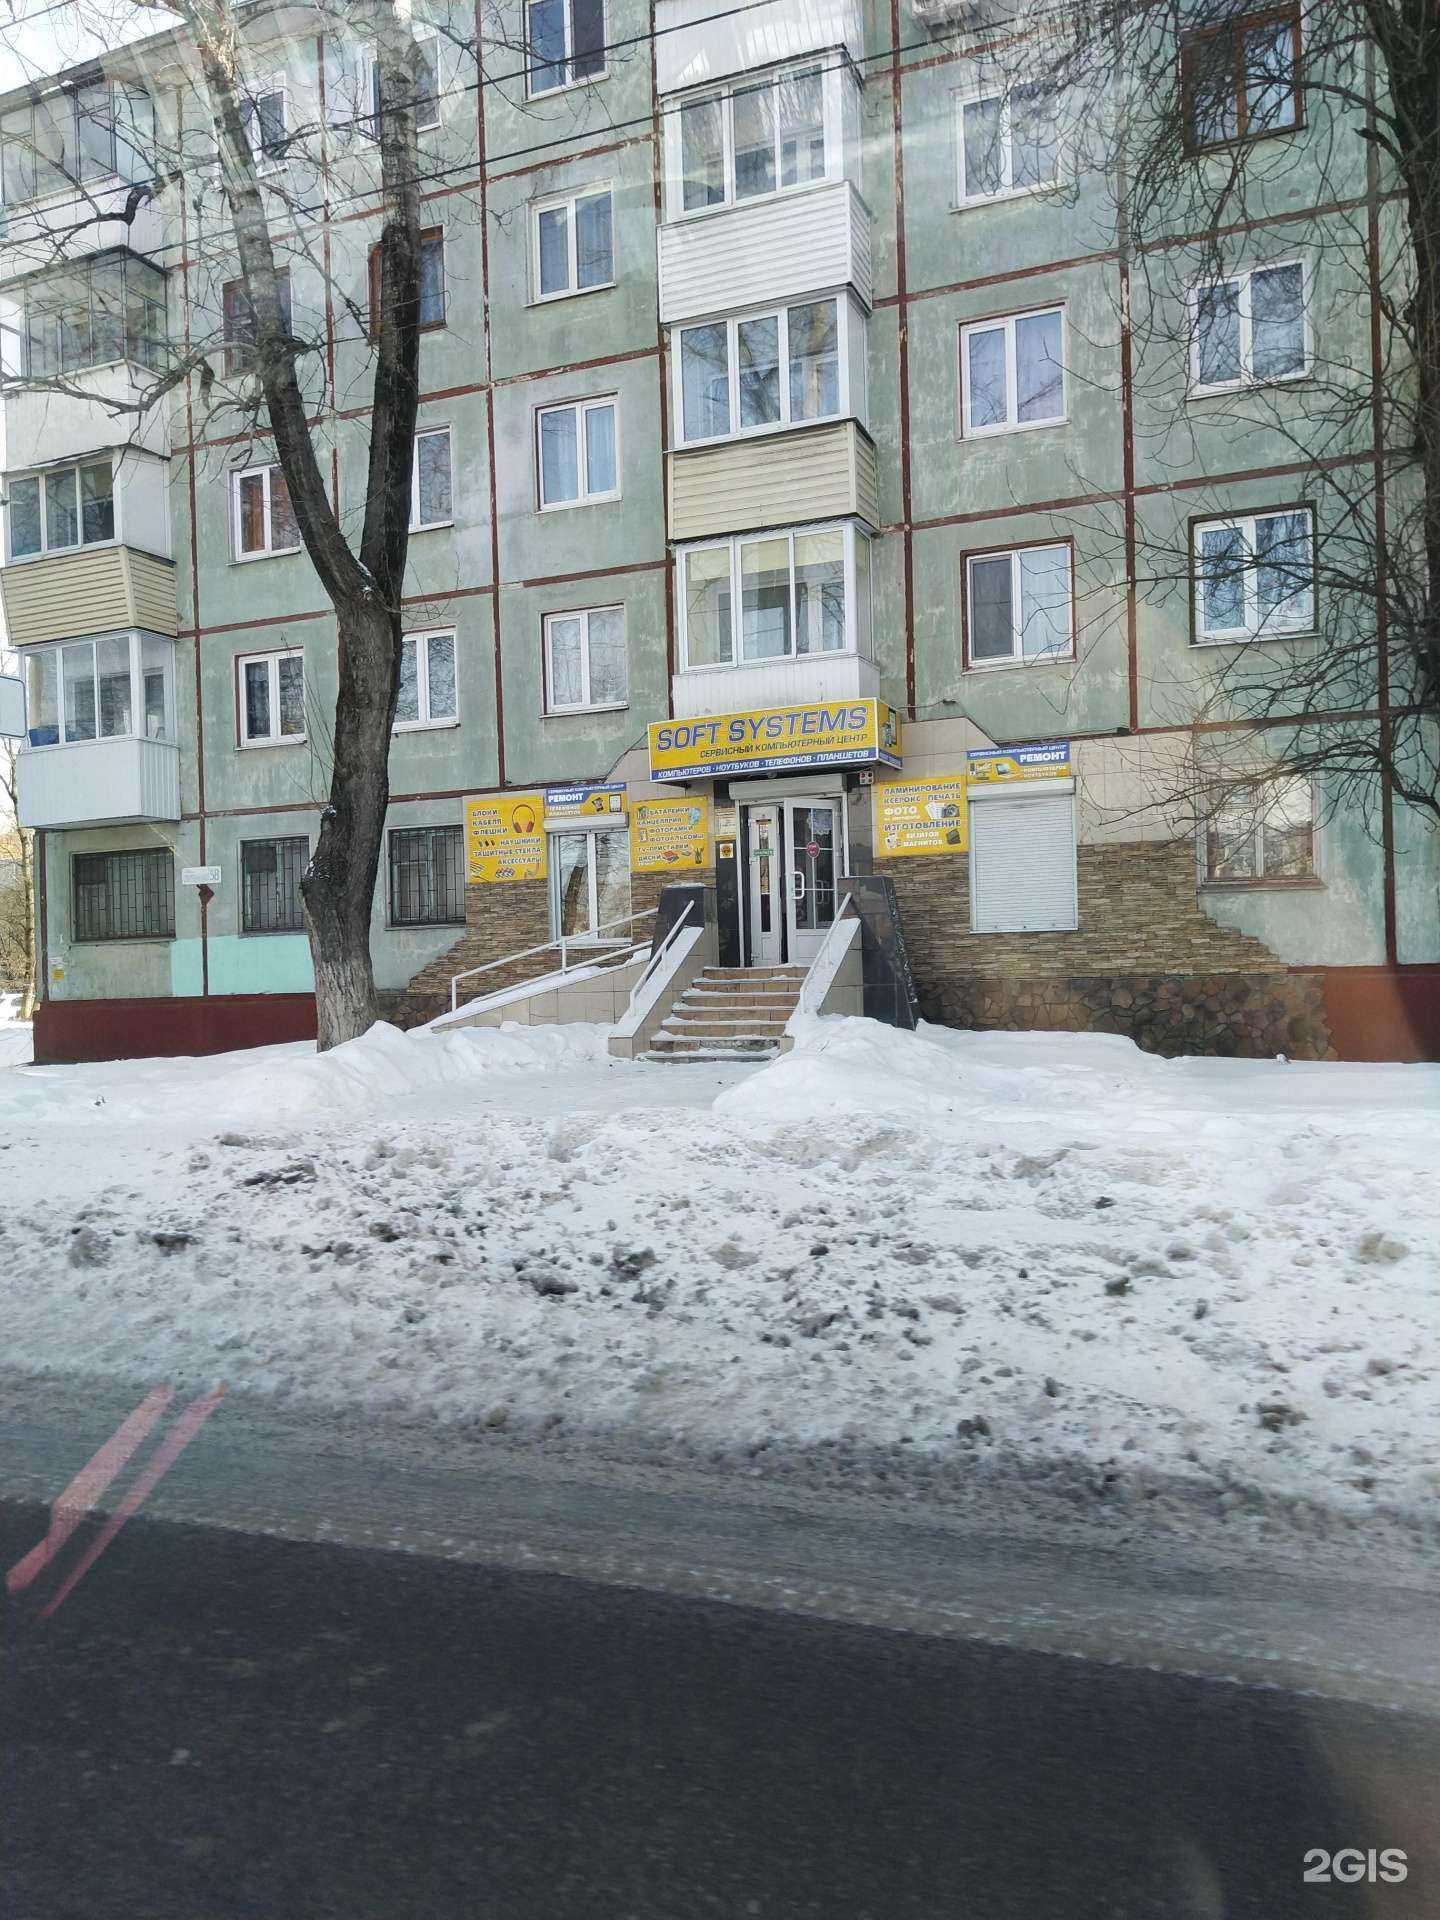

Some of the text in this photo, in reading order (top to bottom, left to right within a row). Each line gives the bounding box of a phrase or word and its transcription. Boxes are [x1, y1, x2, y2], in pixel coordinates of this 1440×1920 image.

[657, 706, 868, 752] SOFT SYSTEMS
[700, 733, 868, 758] СЕРВИСНЫЙ КОМПЬЮТЕРНЫЙ ЦЕНТР
[1019, 751, 1067, 763] РЕМОНТ
[658, 765, 712, 778] КОМПЬЮТЕРОВ
[715, 760, 760, 772] НОУТБУКОВ
[764, 755, 812, 767] ТЕЛЕФОНОВ
[814, 750, 869, 761] ПЛАНШЕТОВ
[884, 783, 960, 795] ЛАМИНИРОВАНИЕ
[548, 793, 584, 803] РЕМОНТ
[884, 793, 960, 804] КСЕРОКС ПЕЧАТЬ
[884, 806, 917, 816] ФОТО
[473, 827, 508, 836] ФЛЕШКИ
[884, 820, 960, 832] ИЗГОТОВЛЕНИЕ
[500, 837, 541, 846] НАУШНИКИ
